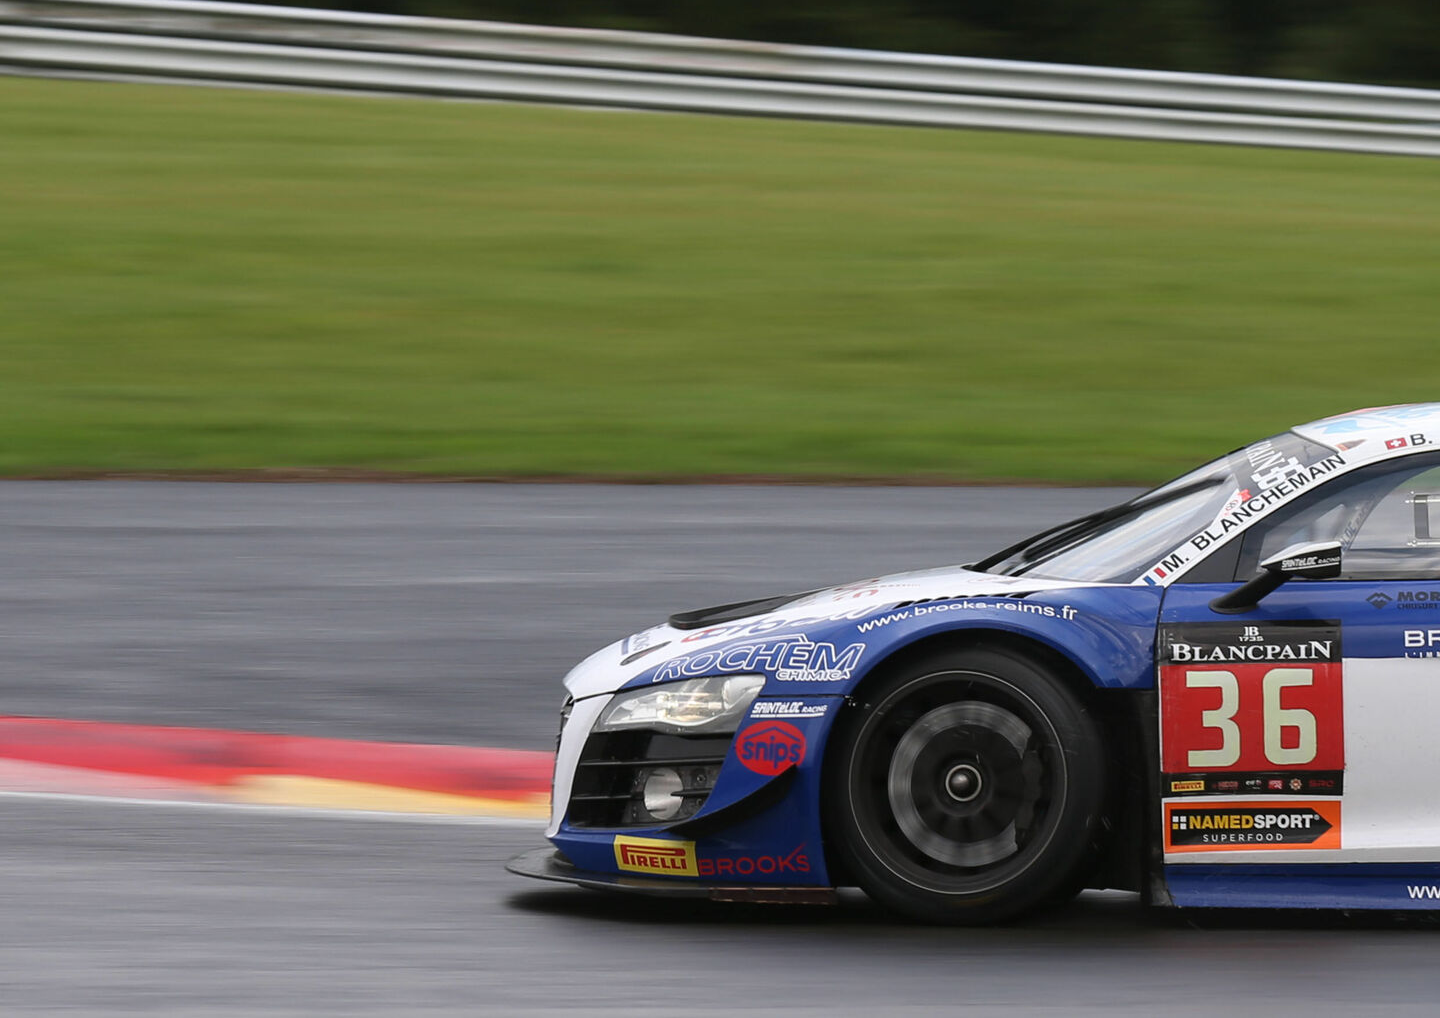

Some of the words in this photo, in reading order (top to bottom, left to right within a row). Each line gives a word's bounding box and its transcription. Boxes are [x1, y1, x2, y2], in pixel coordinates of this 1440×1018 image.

[1410, 433, 1433, 446] B.
[1161, 553, 1190, 573] M.
[1191, 454, 1347, 551] BLANCHEMAIN
[857, 600, 1079, 633] www.brooks-reims.fr
[1170, 640, 1333, 663] BLANCPAIN
[775, 669, 851, 681] CHIMICA
[1185, 668, 1318, 768] 36
[741, 736, 801, 770] snips
[1203, 833, 1284, 842] SUPERFOOD
[619, 843, 688, 870] PIRELLI
[698, 843, 811, 876] BROOKS
